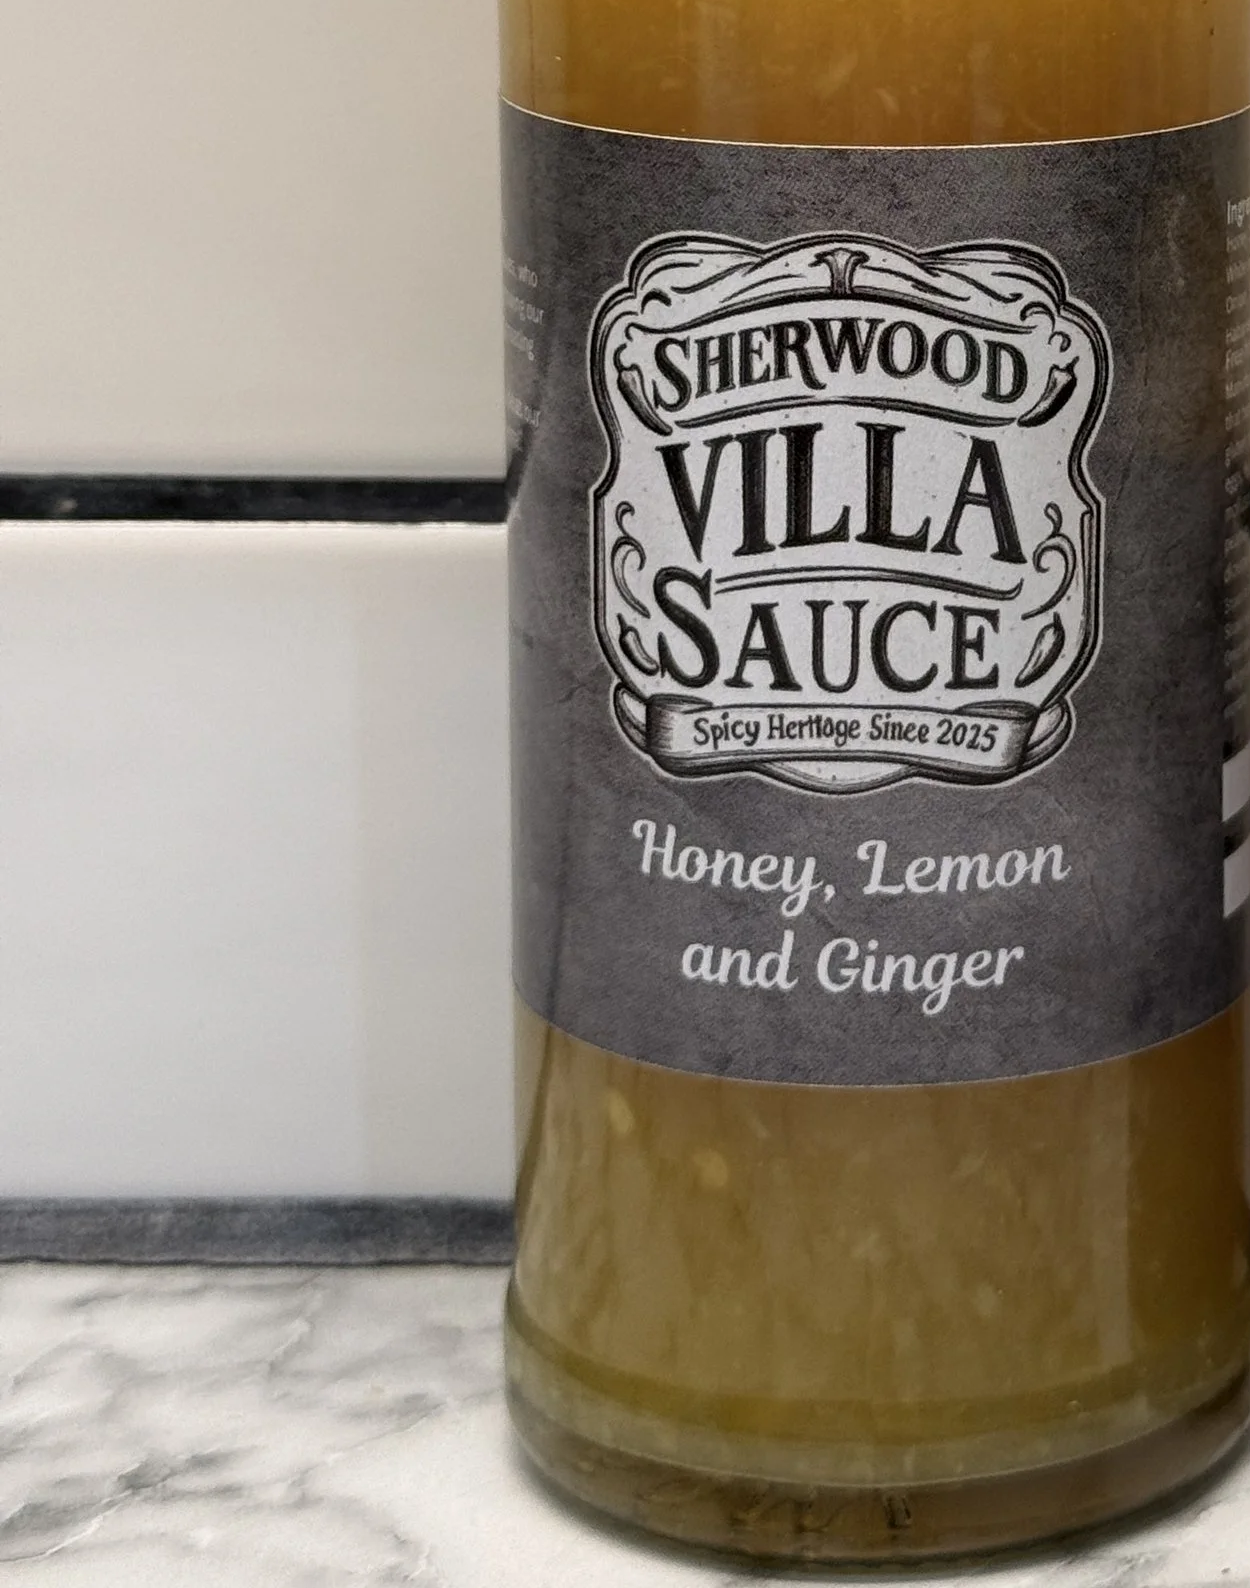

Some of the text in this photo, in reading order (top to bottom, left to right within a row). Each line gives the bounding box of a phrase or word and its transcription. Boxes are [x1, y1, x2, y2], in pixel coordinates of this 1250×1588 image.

[652, 317, 1028, 413] SHERWOOD
[655, 422, 1027, 563] VILLA
[652, 565, 1001, 694] SAUCE
[692, 711, 760, 750] Spicy
[936, 717, 1000, 753] 2025
[632, 818, 1072, 918] Honey, Lemon
[680, 929, 1026, 1016] and Ginger
